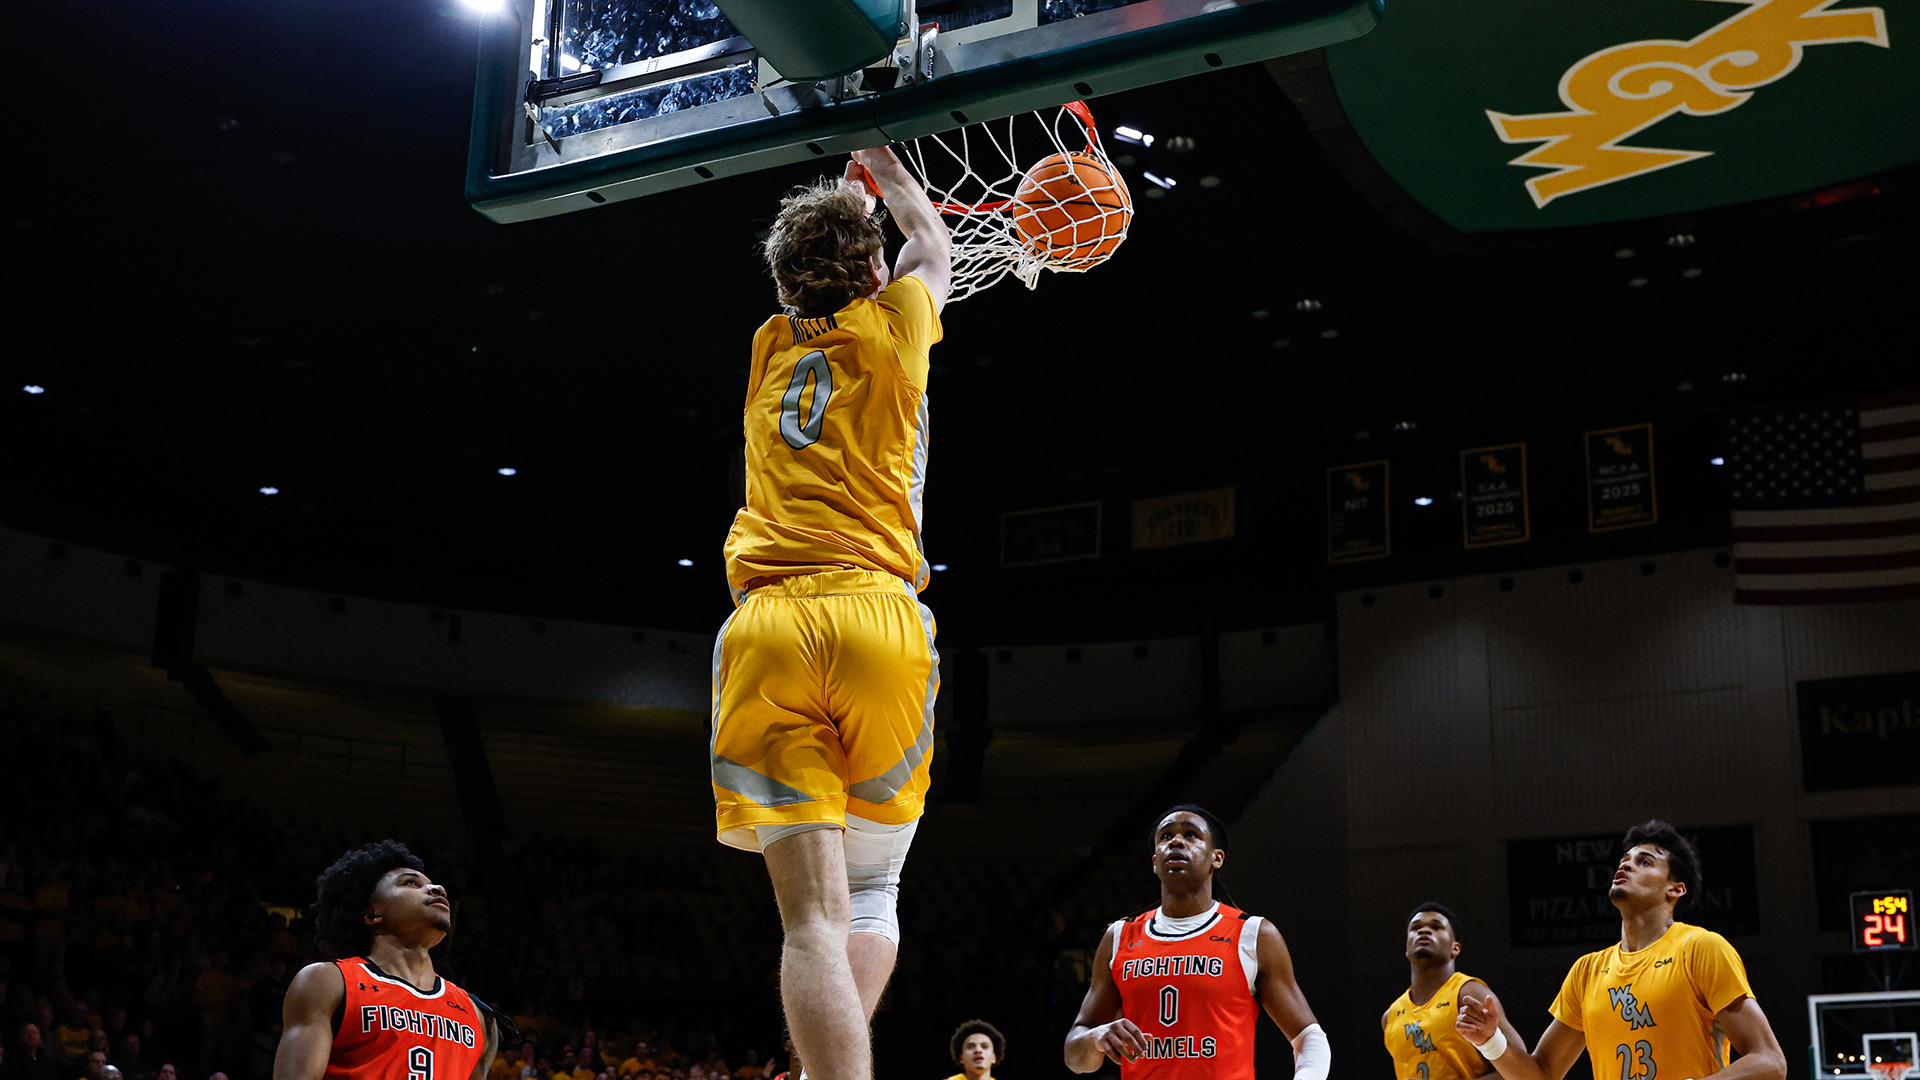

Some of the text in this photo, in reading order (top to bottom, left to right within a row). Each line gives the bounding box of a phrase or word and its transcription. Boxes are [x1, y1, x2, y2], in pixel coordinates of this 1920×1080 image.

[1484, 0, 1890, 210] W&M
[780, 349, 833, 451] 0
[1478, 481, 1508, 493] CAA
[1600, 483, 1641, 500] 2025
[1475, 500, 1514, 517] 2025
[1555, 839, 1615, 864] NEW
[1529, 896, 1591, 920] PIZZA
[1873, 896, 1908, 915] 1:54
[1209, 935, 1232, 944] CAA
[1863, 914, 1906, 946] 24
[1122, 955, 1223, 981] FIGHTING
[446, 1001, 468, 1015] CAA
[1158, 984, 1179, 1027] 0
[1608, 983, 1658, 1031] W&M
[361, 1005, 475, 1049] FIGHTING
[1404, 1020, 1438, 1054] W&M
[1136, 1036, 1217, 1059] AMELS
[1616, 1039, 1658, 1080] 23
[408, 1045, 434, 1080] 9
